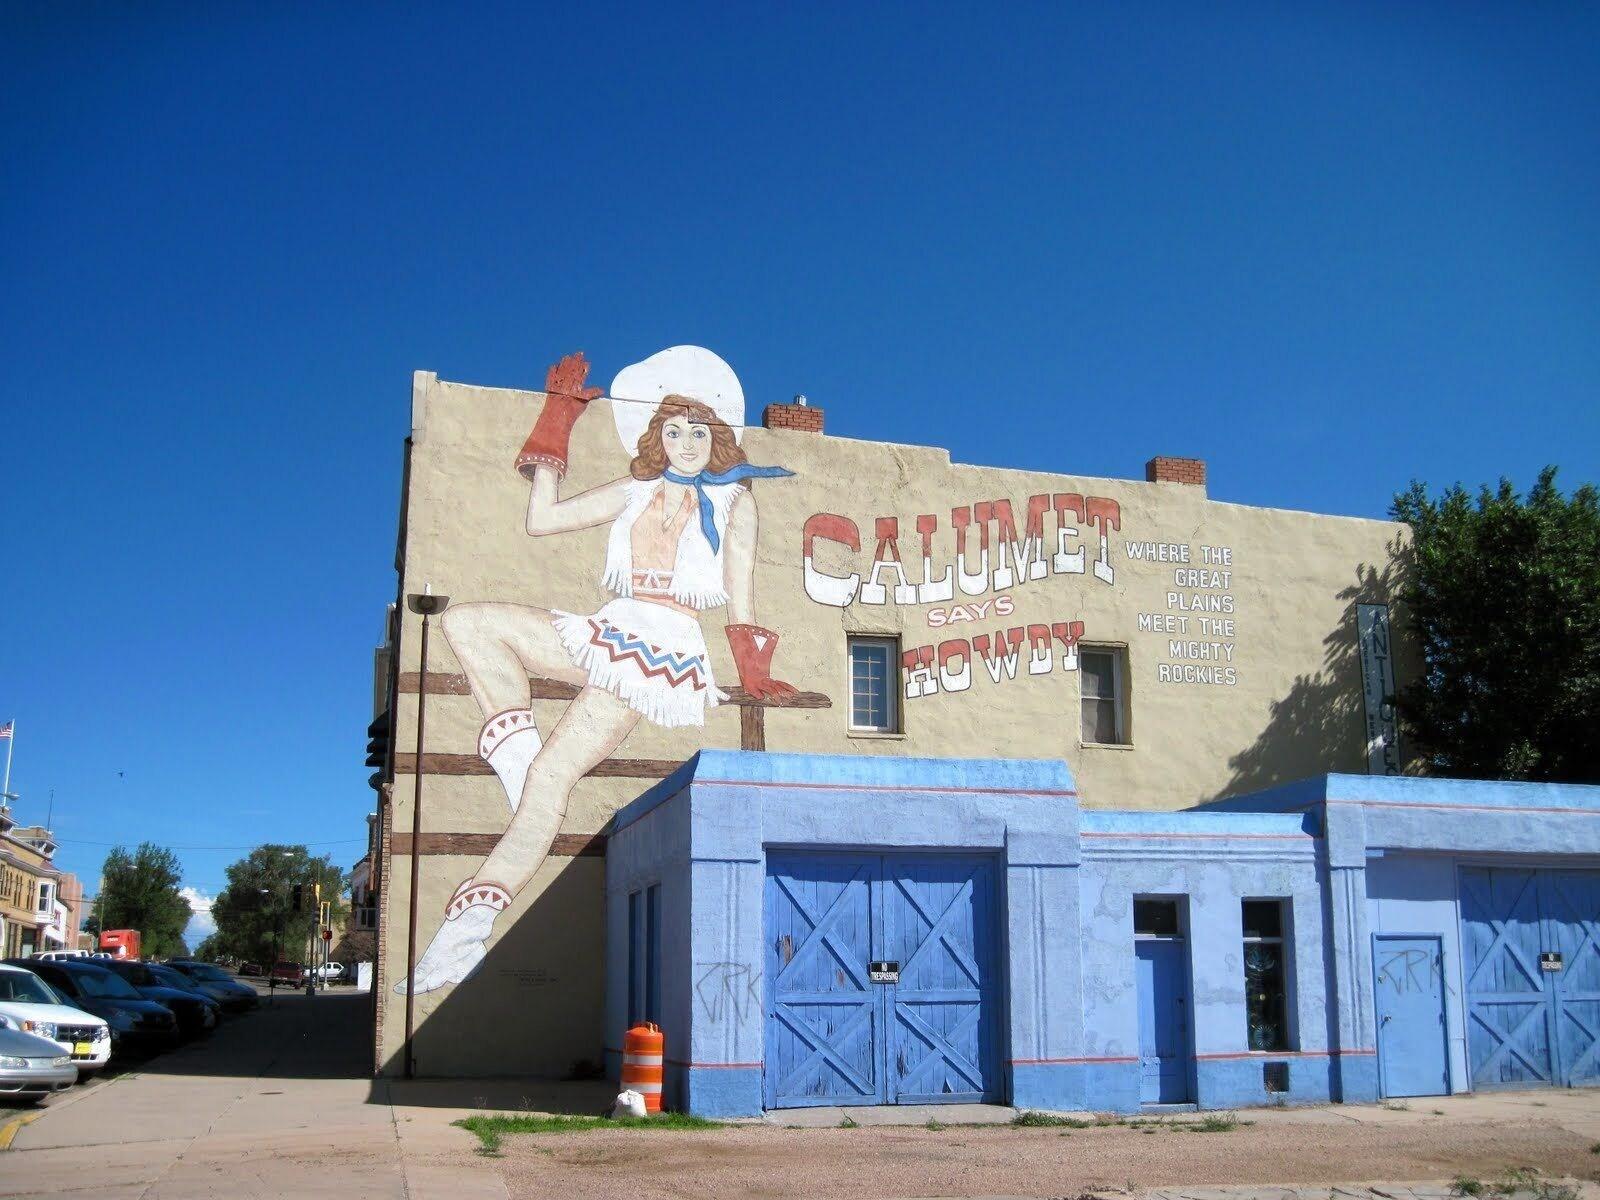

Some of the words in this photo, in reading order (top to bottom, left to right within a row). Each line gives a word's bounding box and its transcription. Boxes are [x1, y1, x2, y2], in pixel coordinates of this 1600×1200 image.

[803, 493, 1121, 608] CALUMET
[1125, 541, 1190, 564] WHERE
[1200, 545, 1232, 566] THE
[1174, 567, 1232, 590] GREAT
[927, 596, 1015, 627] SAYS
[1166, 591, 1235, 614] PLAINS
[1137, 613, 1189, 635] MEET
[1198, 617, 1236, 638] THE
[902, 620, 1085, 699] HOWDY
[1168, 639, 1235, 662] MIGHTY
[1158, 663, 1237, 686] ROCKIES
